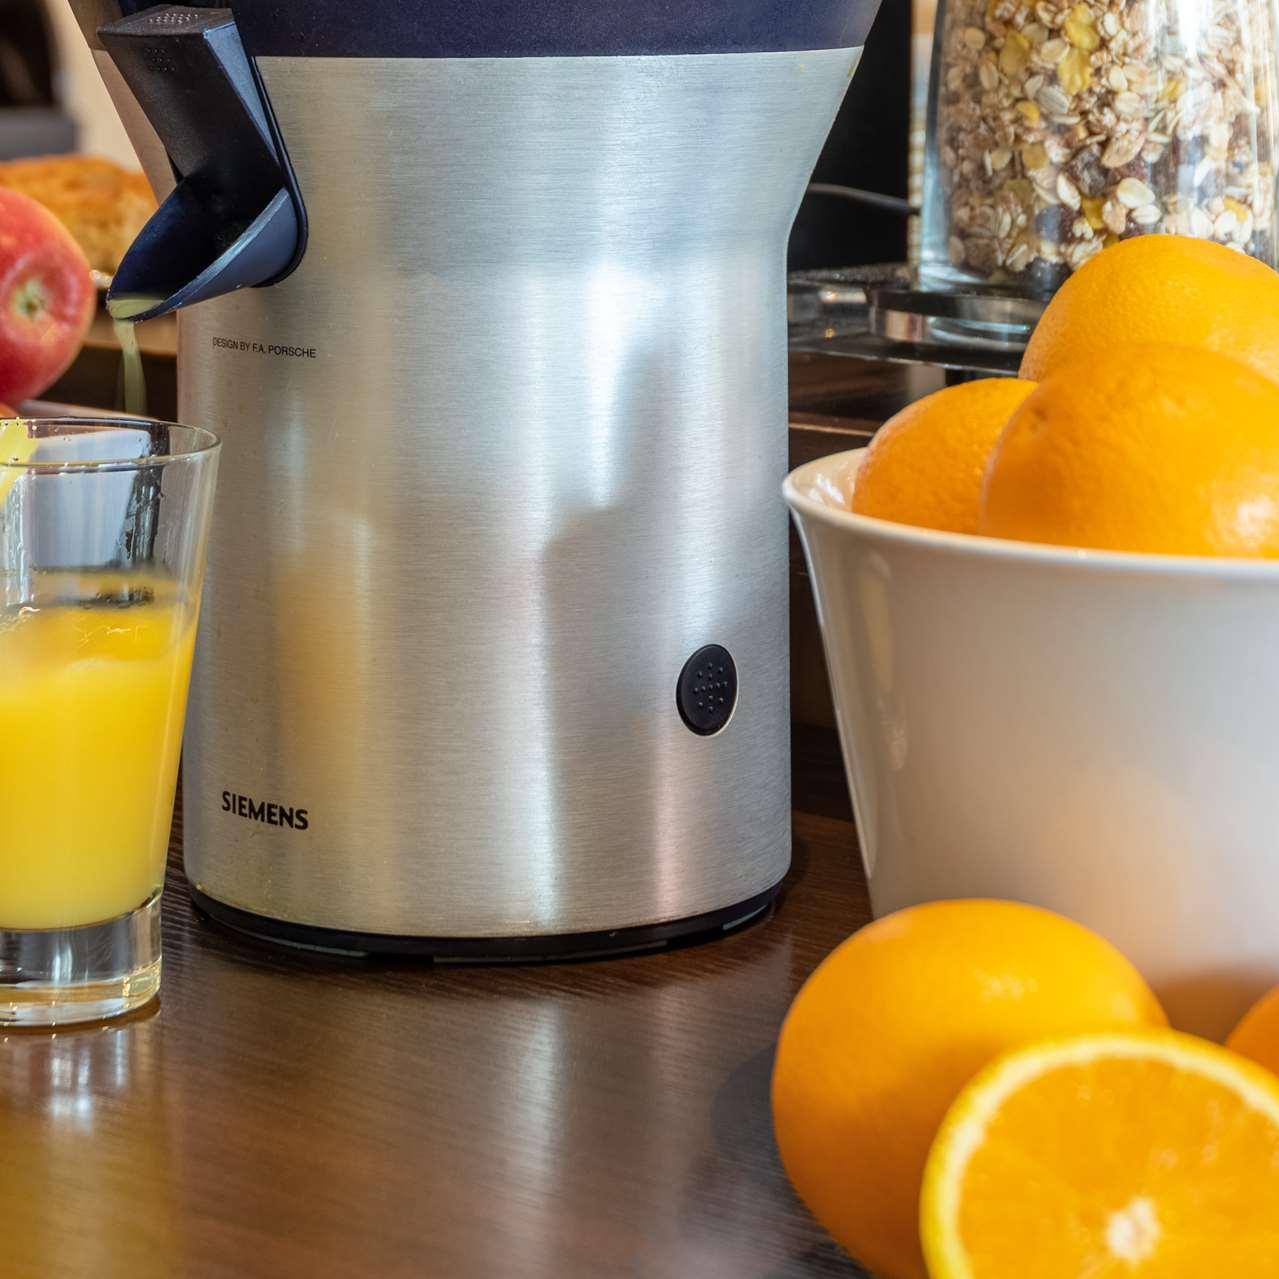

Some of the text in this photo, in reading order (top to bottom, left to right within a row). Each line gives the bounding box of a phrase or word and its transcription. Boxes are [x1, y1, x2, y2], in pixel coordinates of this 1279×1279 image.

[212, 336, 239, 350] DESIGN
[240, 341, 250, 352] BY
[268, 345, 317, 358] PORSCHE
[222, 790, 309, 830] SIEMENS
